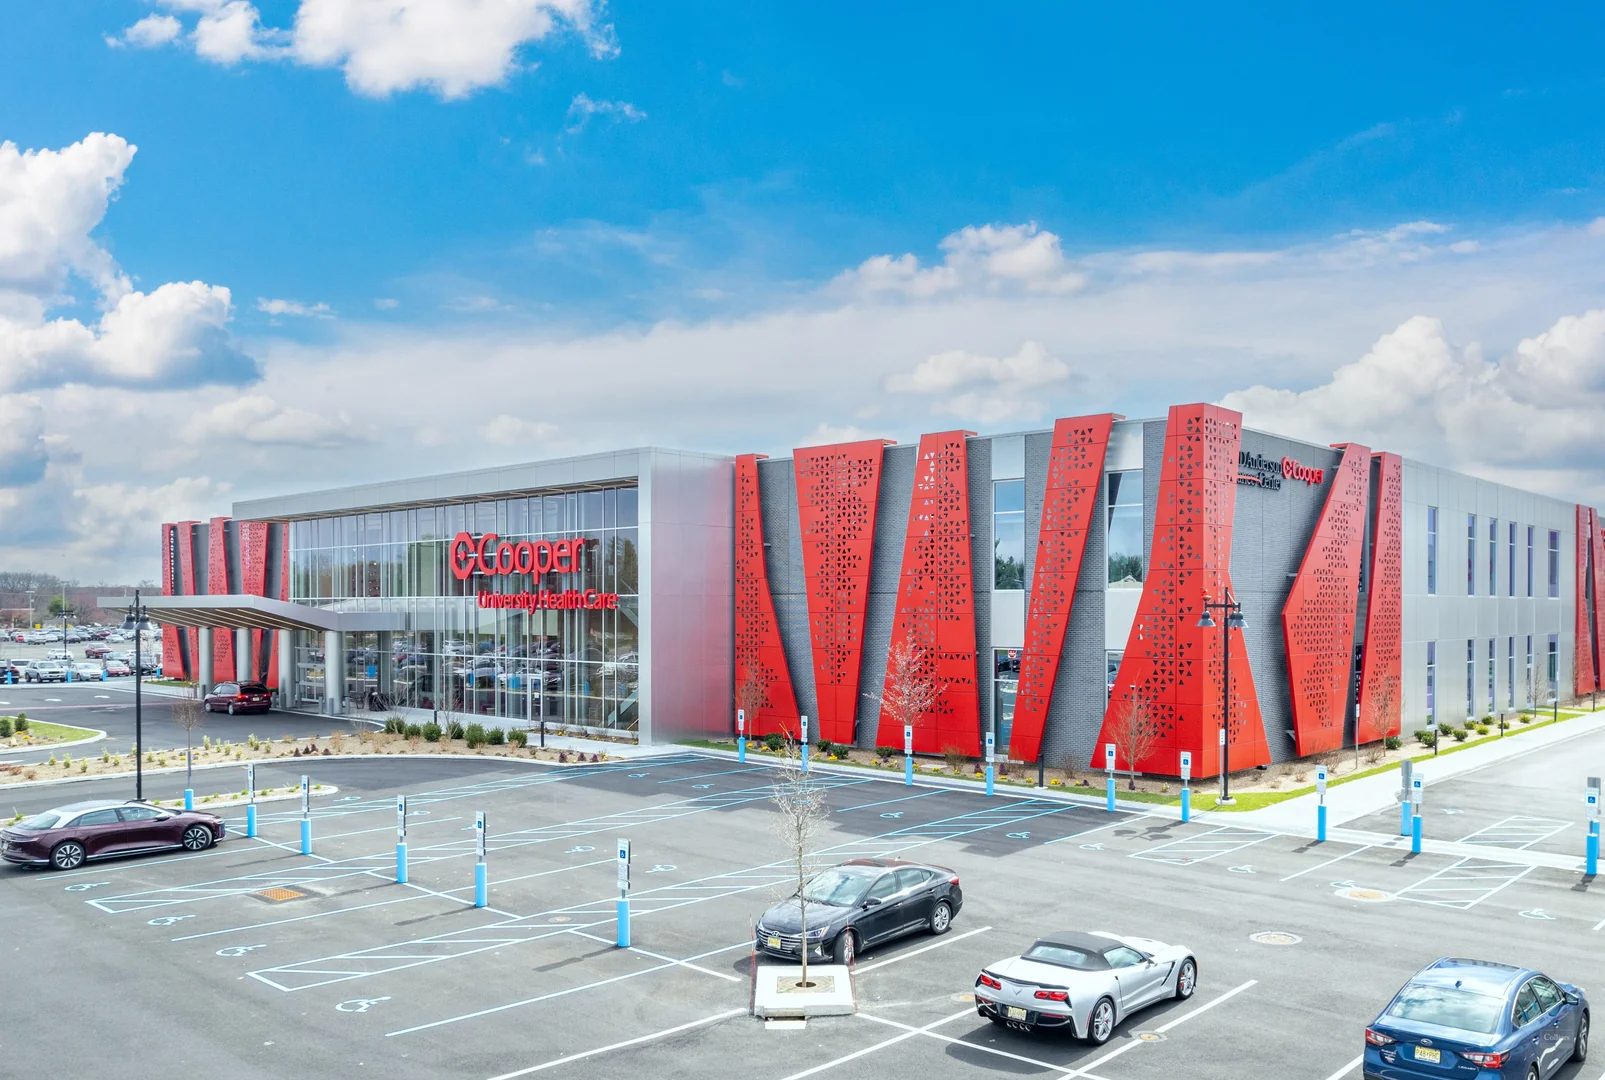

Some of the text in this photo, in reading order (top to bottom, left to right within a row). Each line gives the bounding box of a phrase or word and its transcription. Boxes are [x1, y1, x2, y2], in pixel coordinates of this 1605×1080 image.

[1292, 460, 1324, 486] Cooper
[477, 533, 585, 584] Cooper
[478, 589, 537, 614] University
